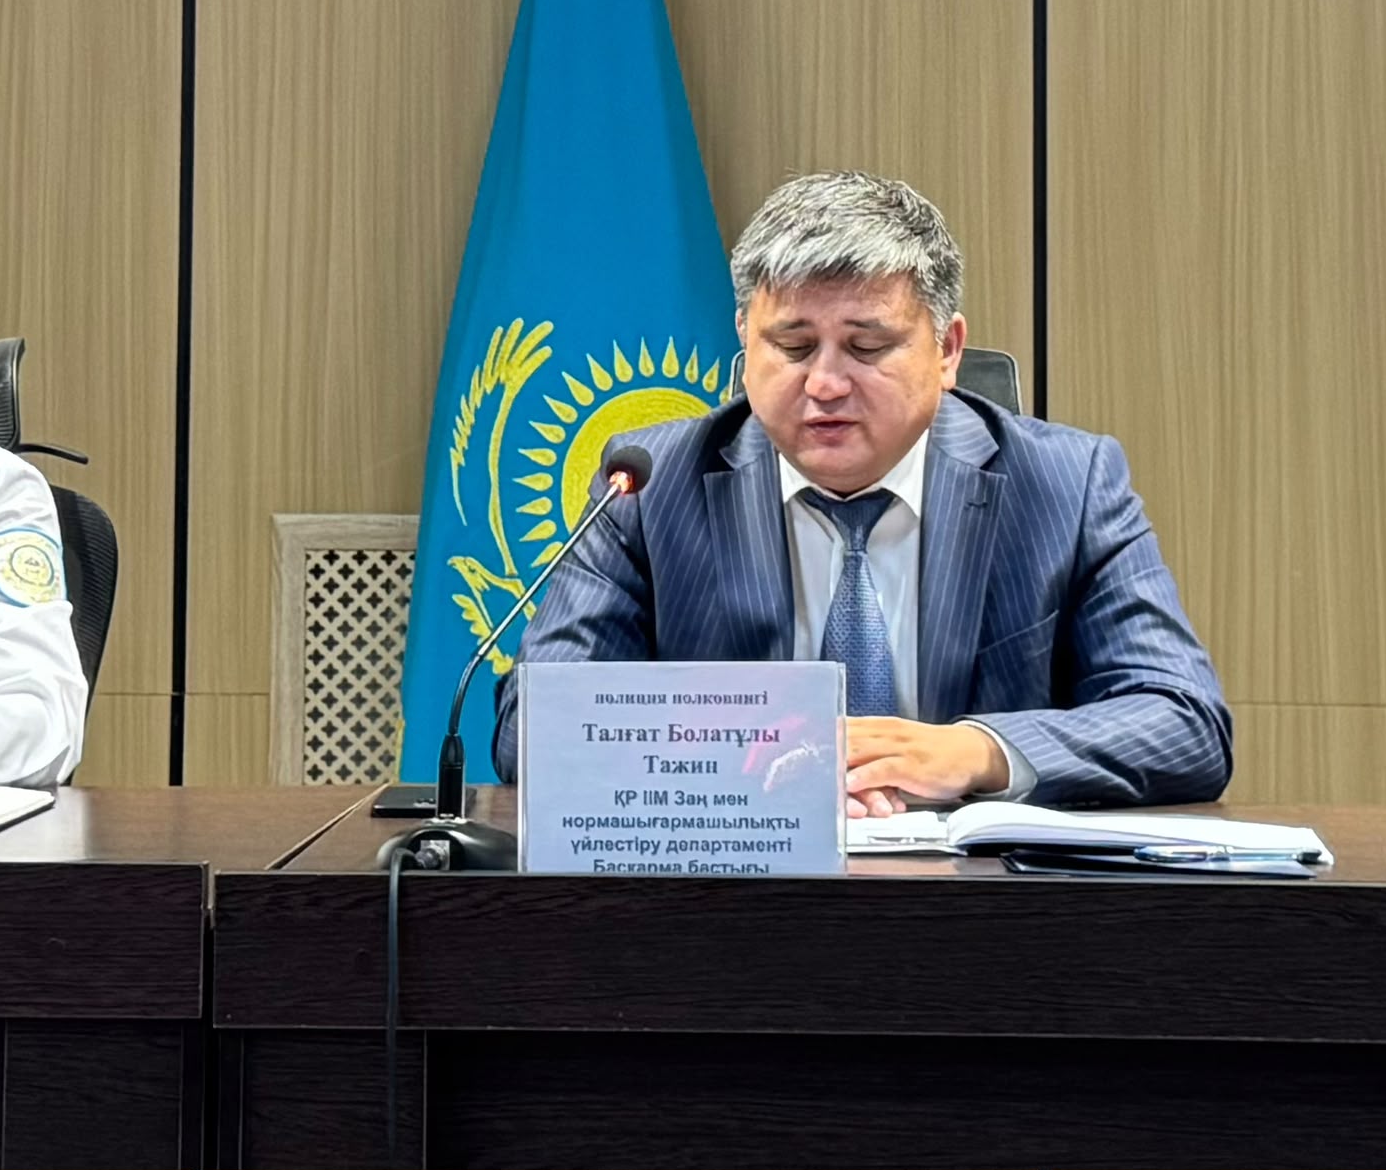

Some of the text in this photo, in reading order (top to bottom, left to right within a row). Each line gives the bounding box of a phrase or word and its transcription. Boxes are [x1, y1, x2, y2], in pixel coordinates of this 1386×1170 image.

[594, 690, 769, 706] полиция полковнигі
[582, 723, 781, 748] Талғат Болатұлы
[643, 754, 718, 774] Тажин
[614, 789, 749, 808] ҚР ІІМ Заң мен
[562, 815, 800, 833] нормашығармашылықты
[571, 835, 792, 856] үйлестіру департаменті
